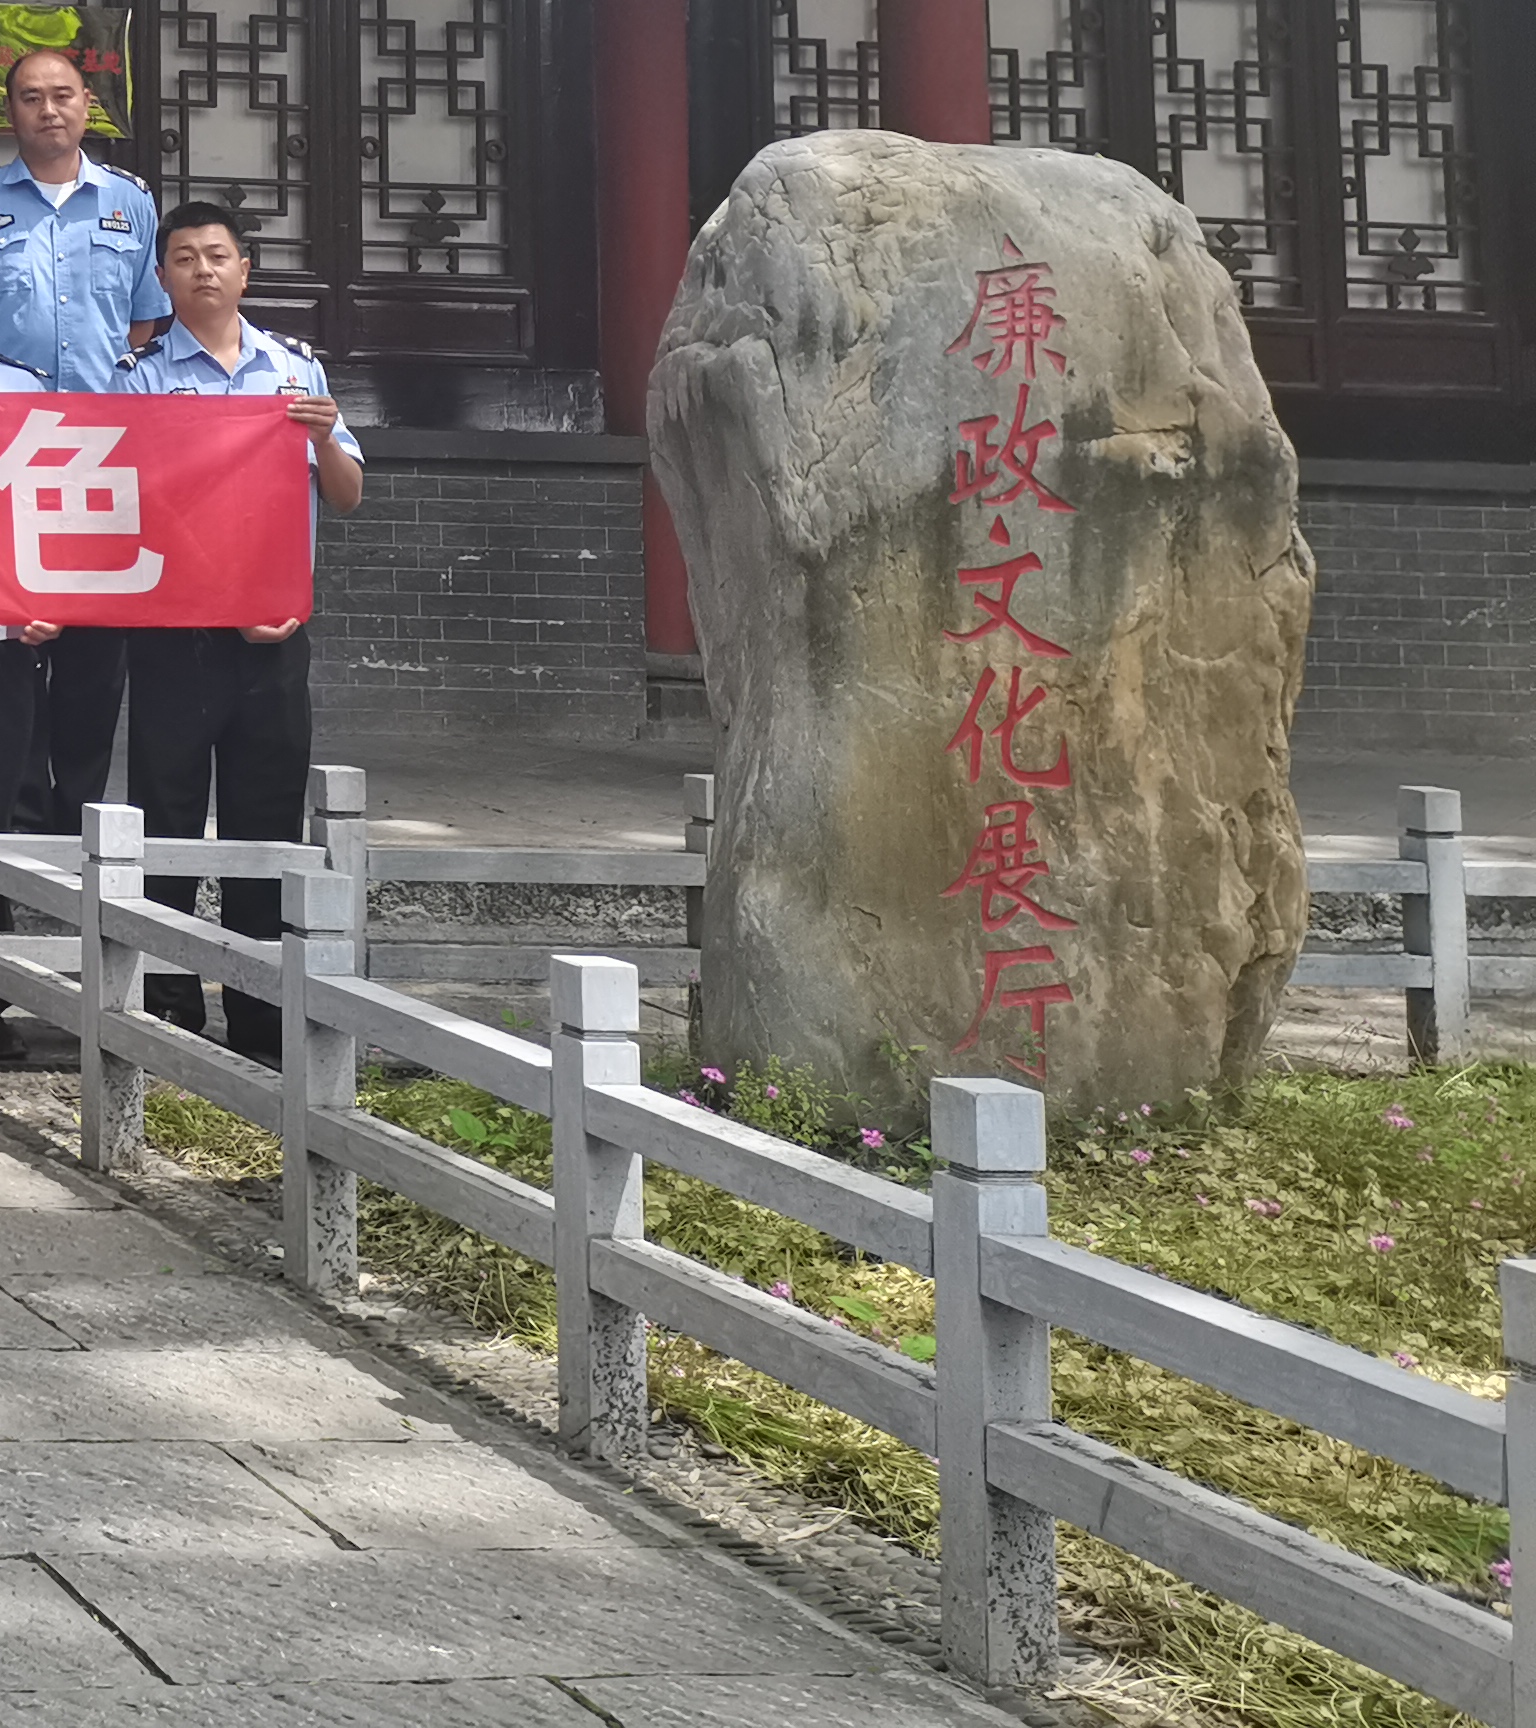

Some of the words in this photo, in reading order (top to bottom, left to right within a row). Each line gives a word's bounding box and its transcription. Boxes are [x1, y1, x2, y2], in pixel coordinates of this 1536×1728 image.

[938, 232, 1080, 1083] 廉政文化展厅
